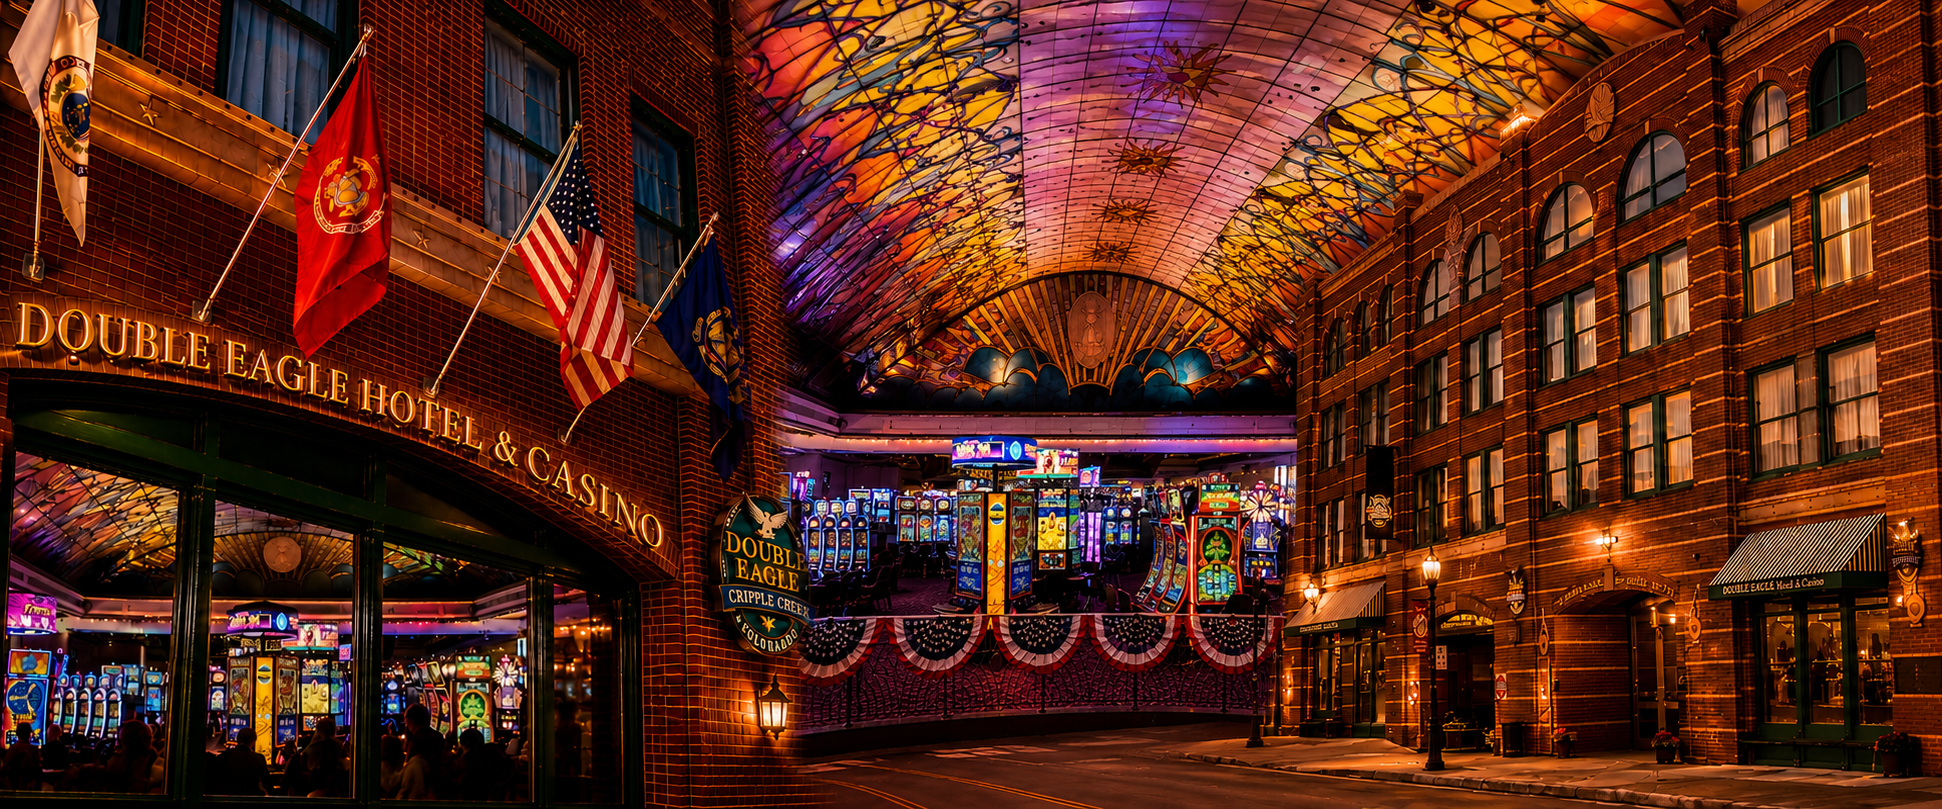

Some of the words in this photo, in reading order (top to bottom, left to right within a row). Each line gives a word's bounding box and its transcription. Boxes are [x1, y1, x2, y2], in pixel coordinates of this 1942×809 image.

[15, 302, 211, 373] DOUBLE
[224, 339, 349, 408] EAGLE
[358, 378, 483, 451] HOTEL
[491, 430, 519, 467] &
[526, 446, 664, 548] CASINO
[725, 531, 807, 572] DOUBLE
[735, 557, 800, 593] EAGLE
[728, 588, 775, 608] CRIPPLE
[777, 596, 810, 620] CREEK
